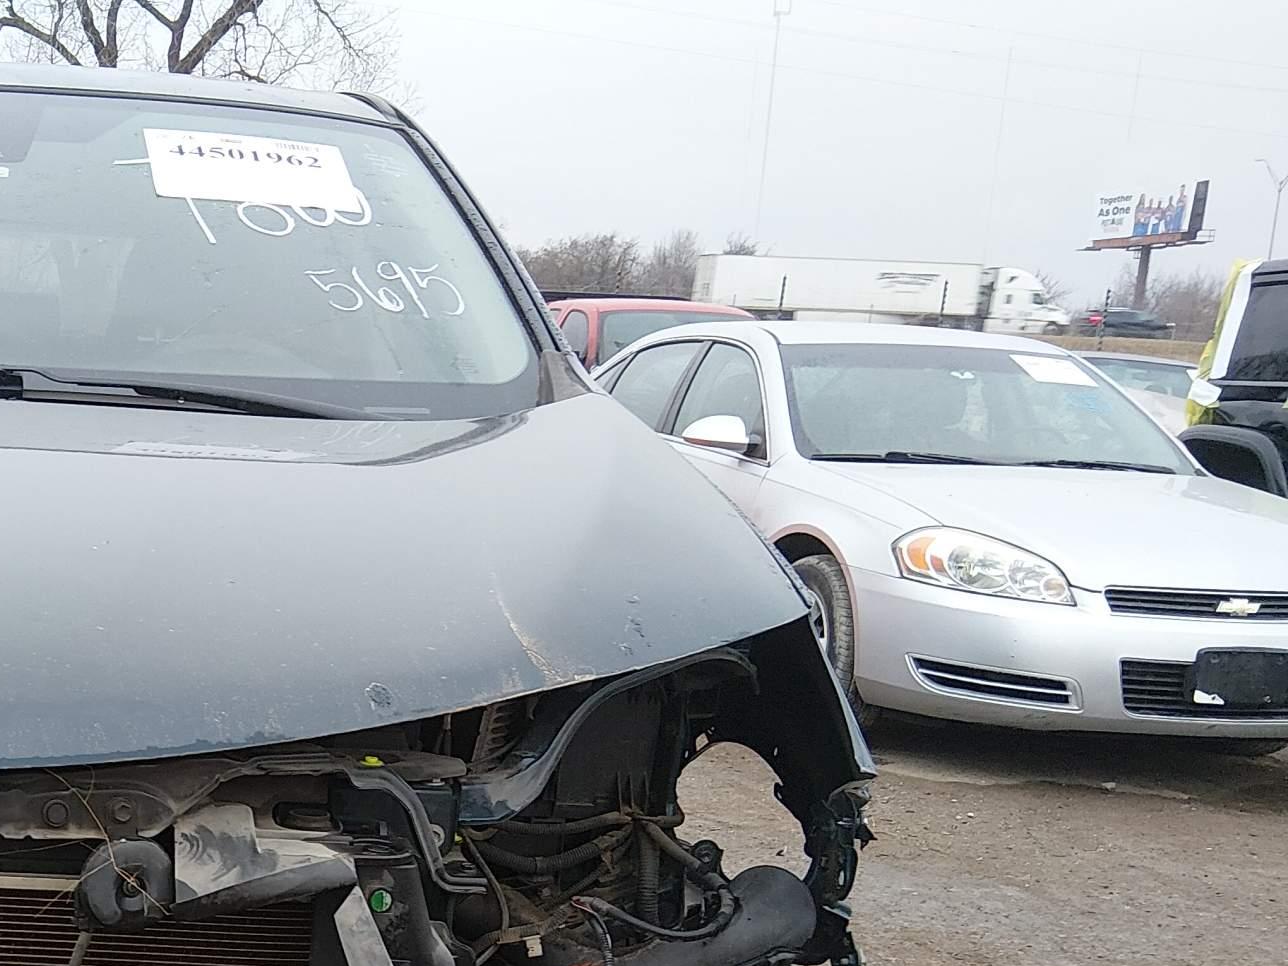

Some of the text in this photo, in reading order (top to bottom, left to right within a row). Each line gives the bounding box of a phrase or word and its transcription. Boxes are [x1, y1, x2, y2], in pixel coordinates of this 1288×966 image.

[169, 145, 322, 168] 44501962
[1100, 195, 1132, 205] Together
[1097, 206, 1131, 217] As One
[303, 261, 465, 319] 5695
